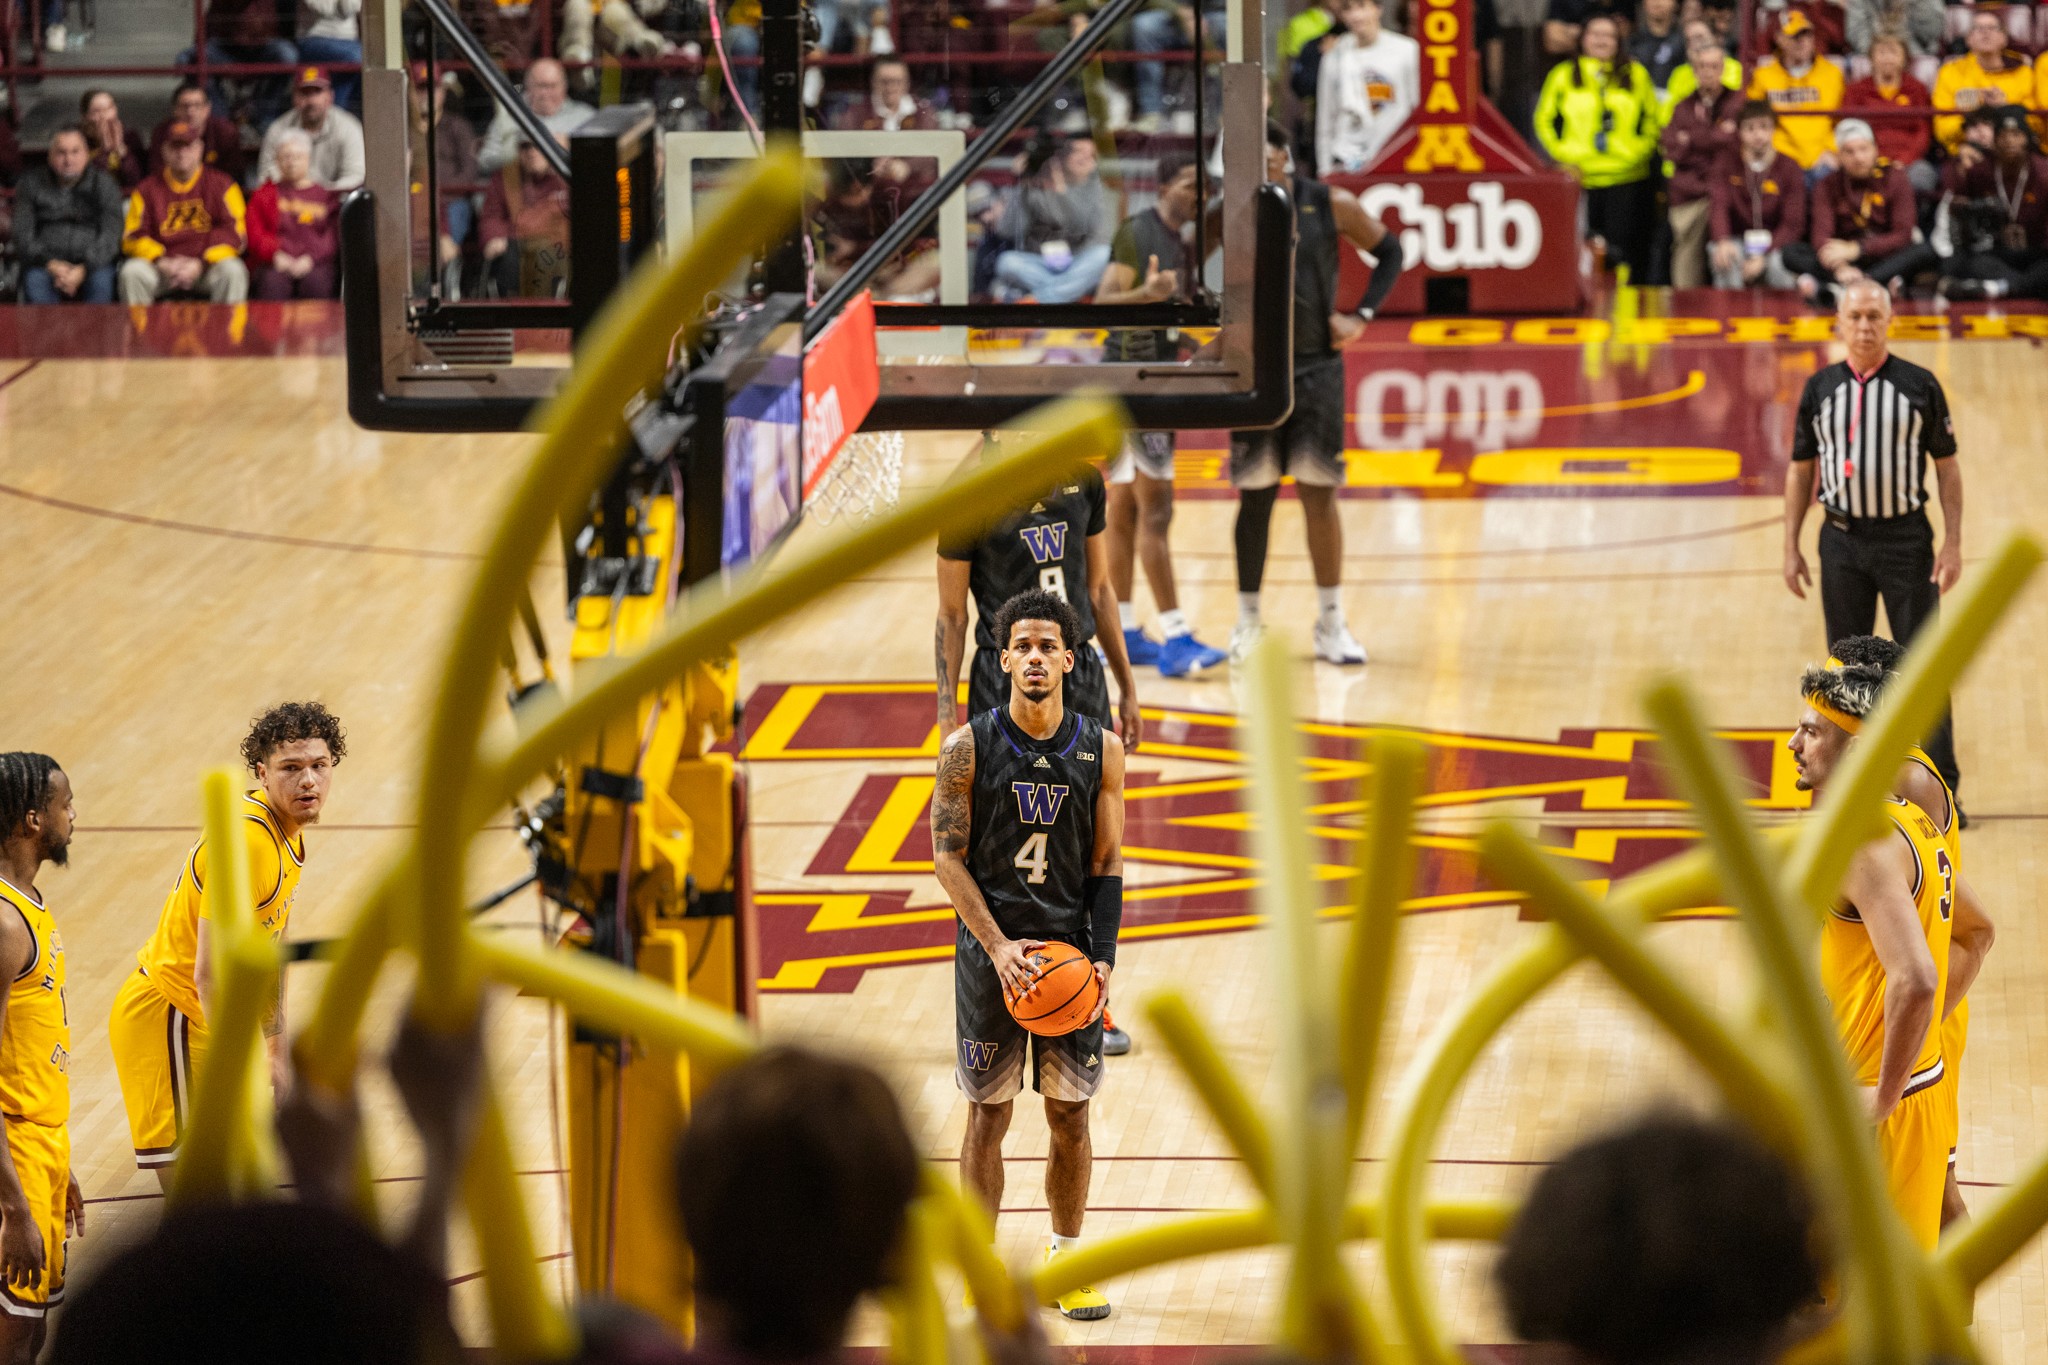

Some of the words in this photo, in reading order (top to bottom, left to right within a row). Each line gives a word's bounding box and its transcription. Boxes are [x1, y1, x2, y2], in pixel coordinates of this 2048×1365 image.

[1357, 182, 1542, 272] Cub
[1019, 521, 1069, 564] W
[1012, 781, 1069, 825] W
[1014, 832, 1049, 884] 4
[1936, 848, 1953, 922] 3
[963, 1038, 998, 1071] W
